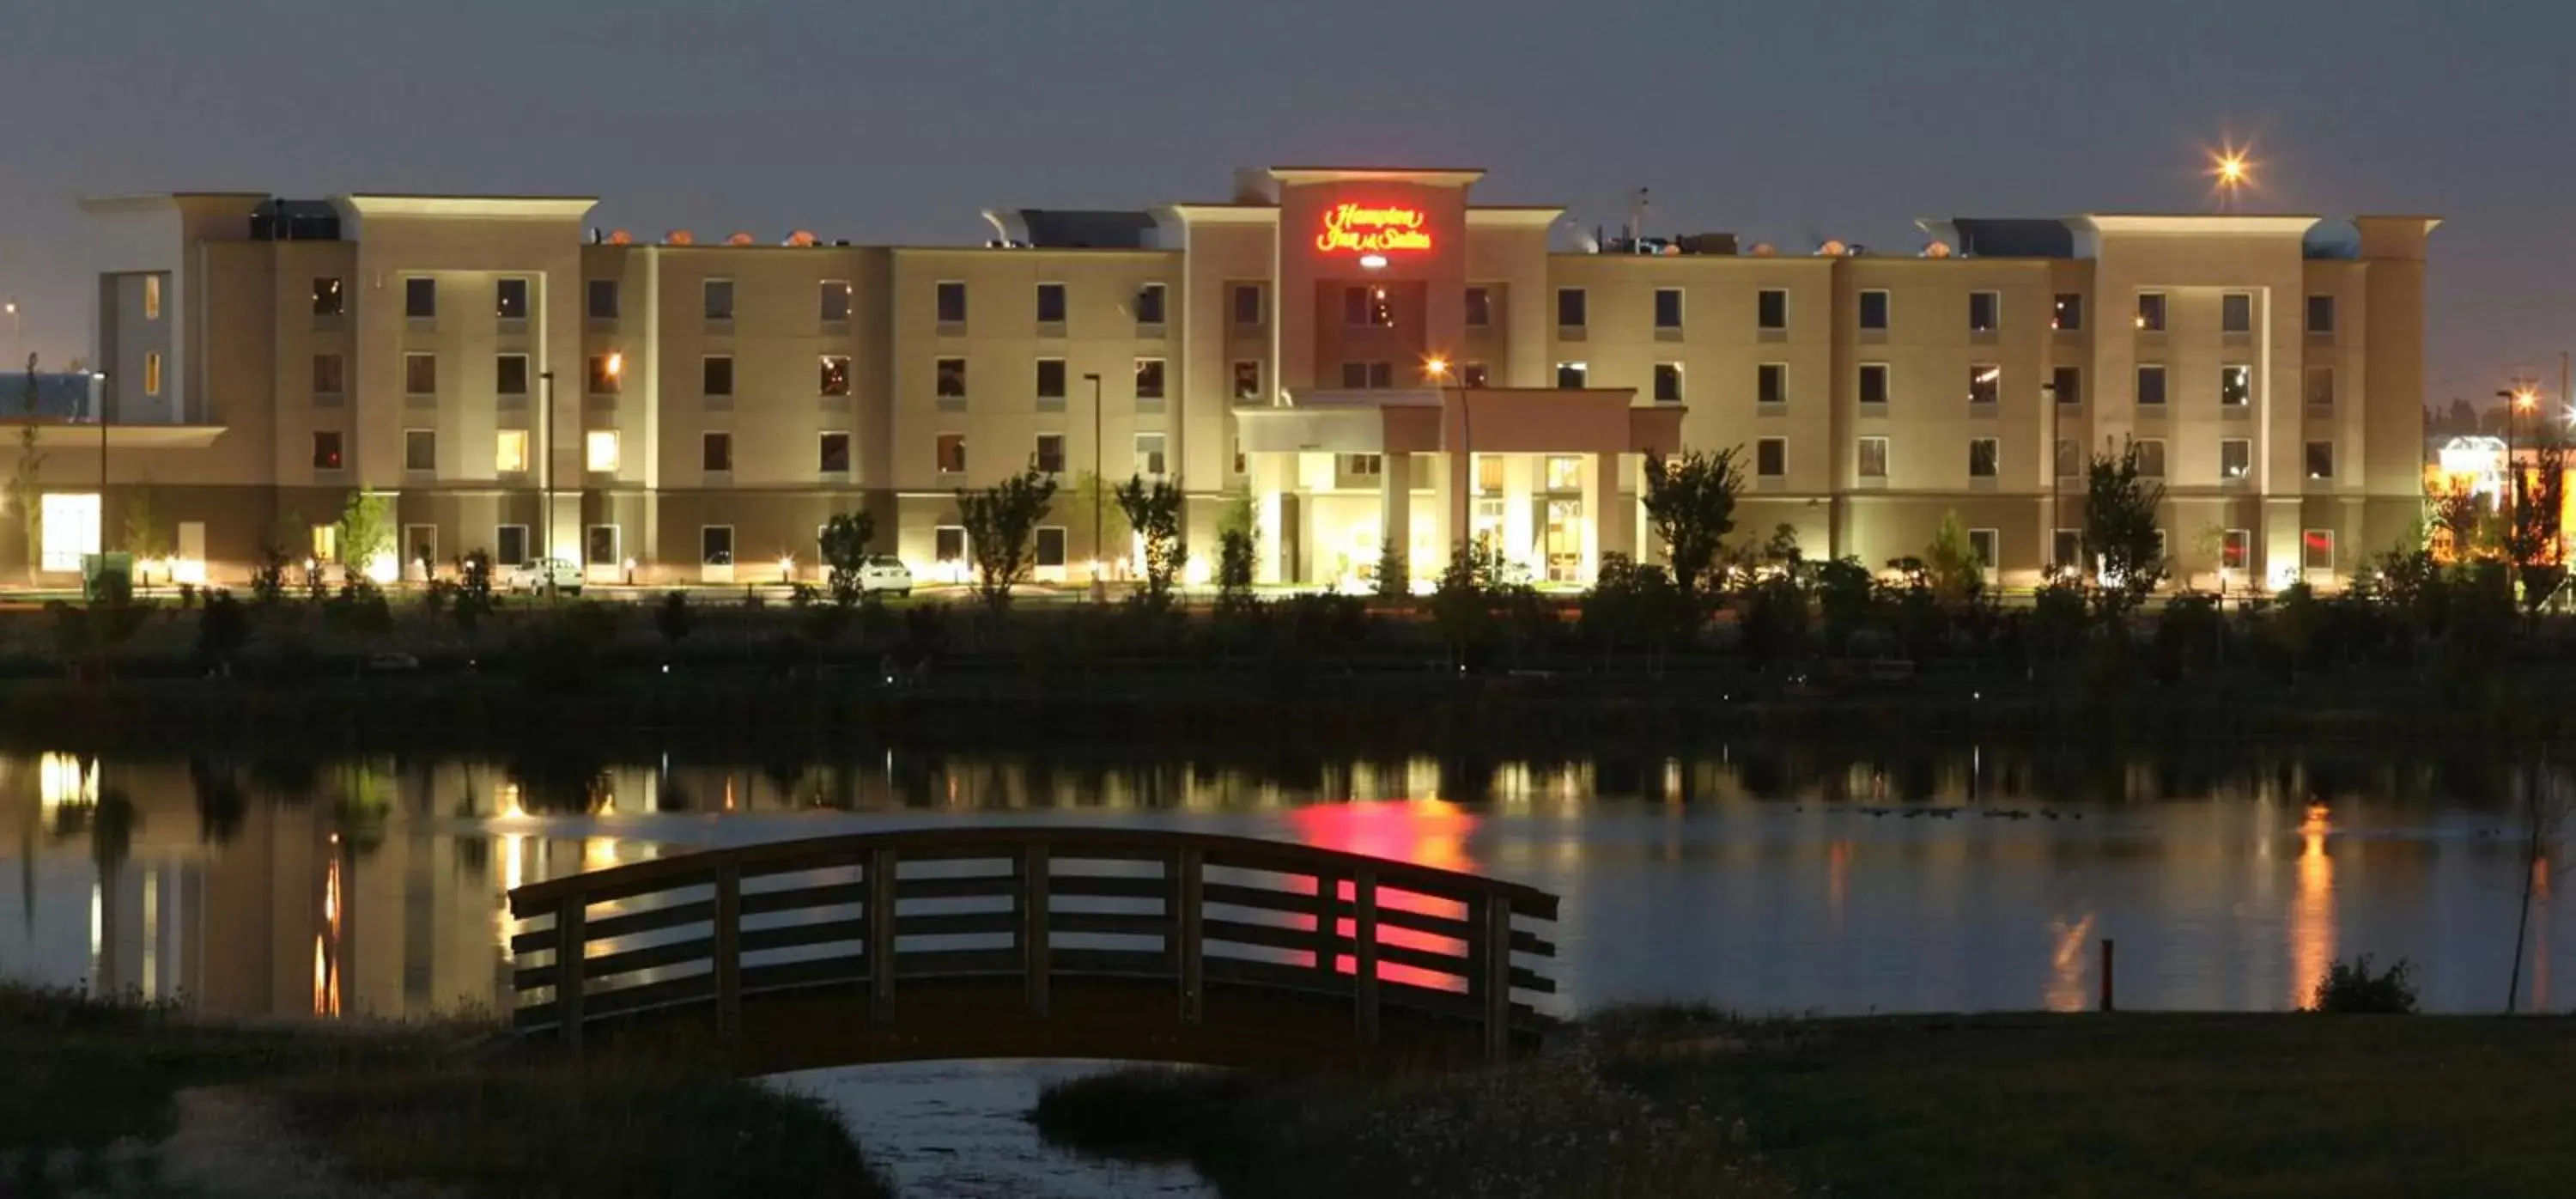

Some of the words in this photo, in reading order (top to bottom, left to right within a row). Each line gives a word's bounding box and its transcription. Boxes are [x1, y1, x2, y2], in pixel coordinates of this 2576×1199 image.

[1325, 203, 1424, 228] Hampton
[1316, 227, 1365, 251] Inn
[1378, 228, 1431, 249] Suites
